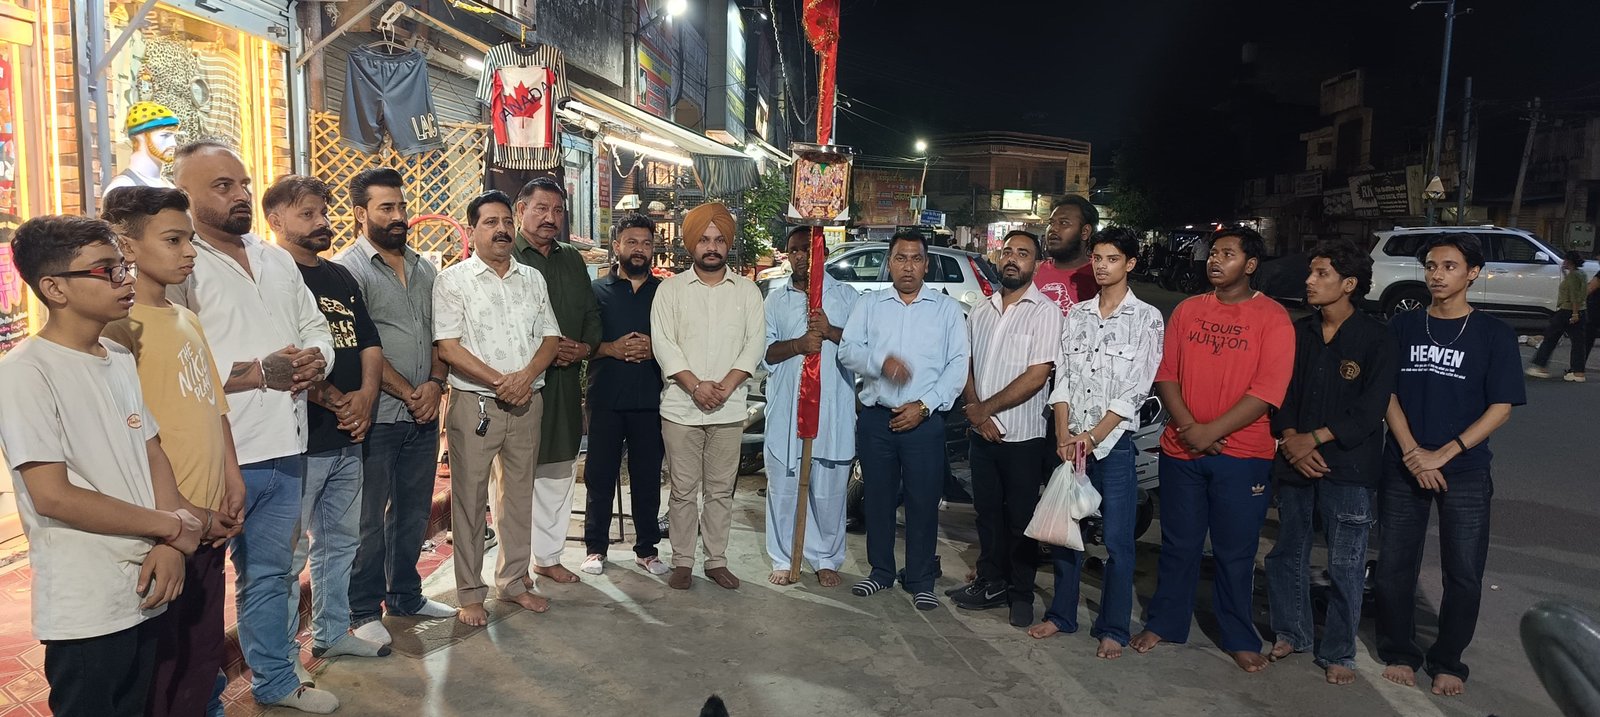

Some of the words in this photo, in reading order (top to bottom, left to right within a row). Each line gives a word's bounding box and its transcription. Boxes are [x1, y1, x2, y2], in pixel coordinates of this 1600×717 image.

[411, 113, 438, 141] LAC
[1201, 320, 1243, 336] LOUIS
[177, 341, 194, 366] THE
[1410, 345, 1465, 368] HEAVEN
[178, 347, 208, 398] NIKE
